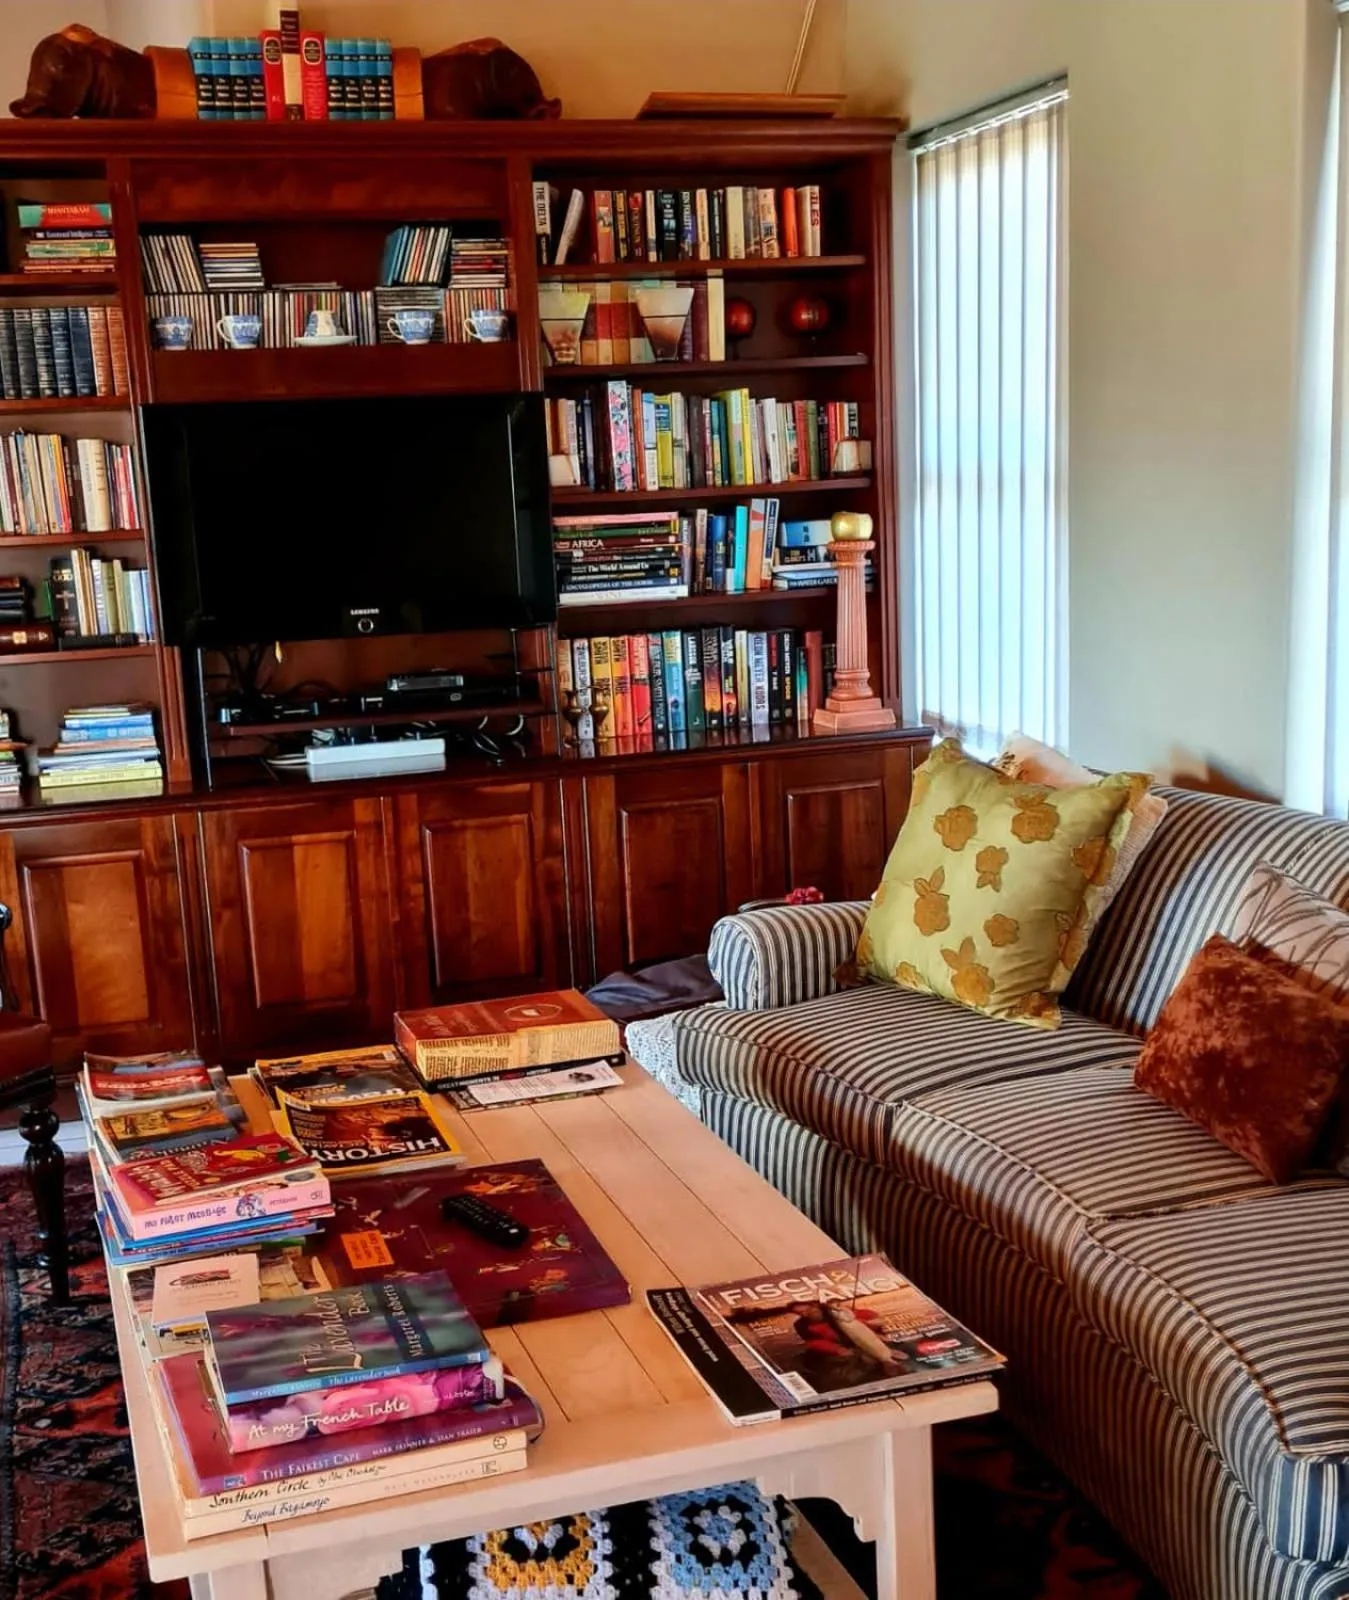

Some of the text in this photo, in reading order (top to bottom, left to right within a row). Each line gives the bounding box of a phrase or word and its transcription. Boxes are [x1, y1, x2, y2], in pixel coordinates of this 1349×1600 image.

[535, 187, 546, 201] THE
[537, 202, 548, 227] DELTA
[572, 538, 604, 549] AFRICA
[310, 1136, 441, 1162] HISTORY
[720, 1272, 834, 1305] FISCH
[383, 1283, 425, 1359] Margaret Roberts
[248, 1397, 411, 1440] At my French Table
[262, 1469, 283, 1481] THE
[287, 1458, 330, 1477] FAIREST
[332, 1453, 361, 1469] CAPE
[372, 1446, 393, 1456] MARK
[394, 1438, 428, 1451] SKINNER
[209, 1487, 270, 1508] Southern
[276, 1478, 312, 1495] Circle
[241, 1506, 277, 1524] Beyond
